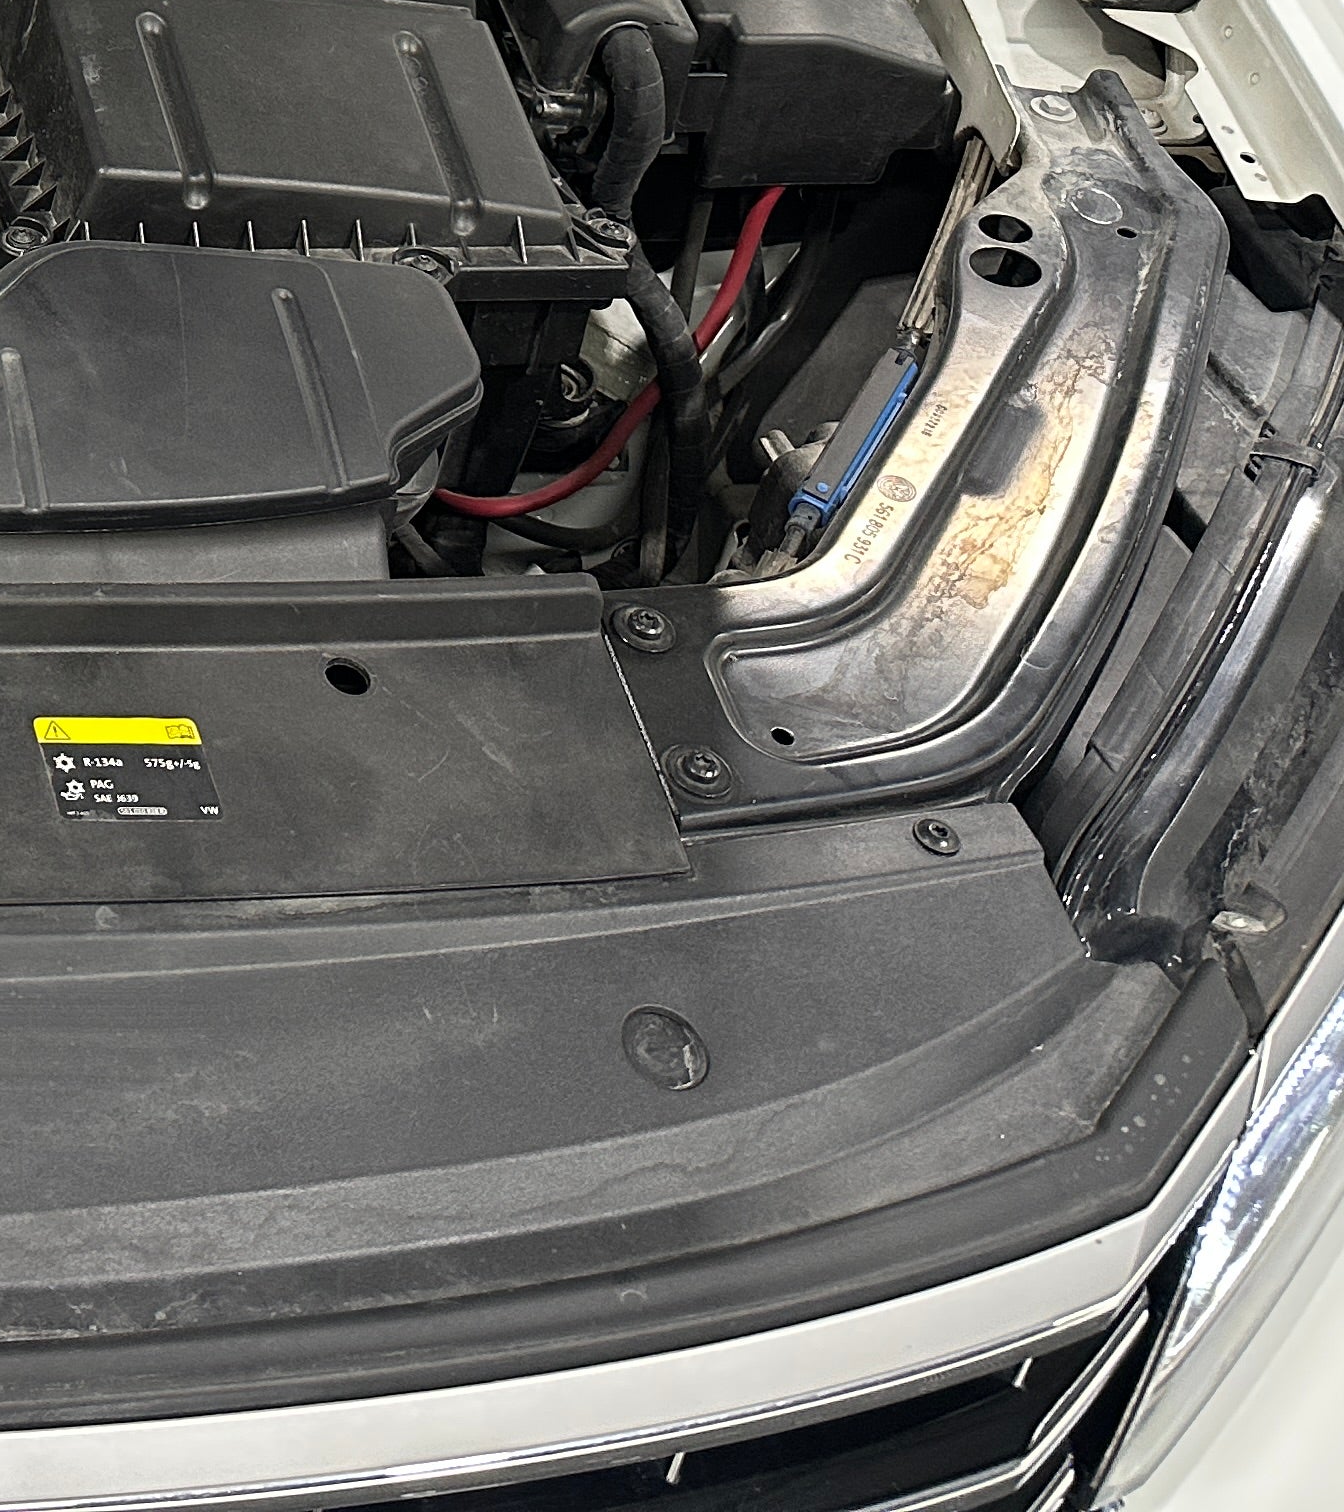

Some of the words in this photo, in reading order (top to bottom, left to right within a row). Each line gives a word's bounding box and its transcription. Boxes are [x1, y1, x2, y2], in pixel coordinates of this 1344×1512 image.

[873, 502, 895, 521] 561
[862, 519, 884, 538] 805
[851, 536, 872, 555] 931
[82, 757, 124, 767] R-134a
[90, 779, 114, 789] PAG
[94, 794, 113, 803] SAE
[200, 806, 219, 815] VW
